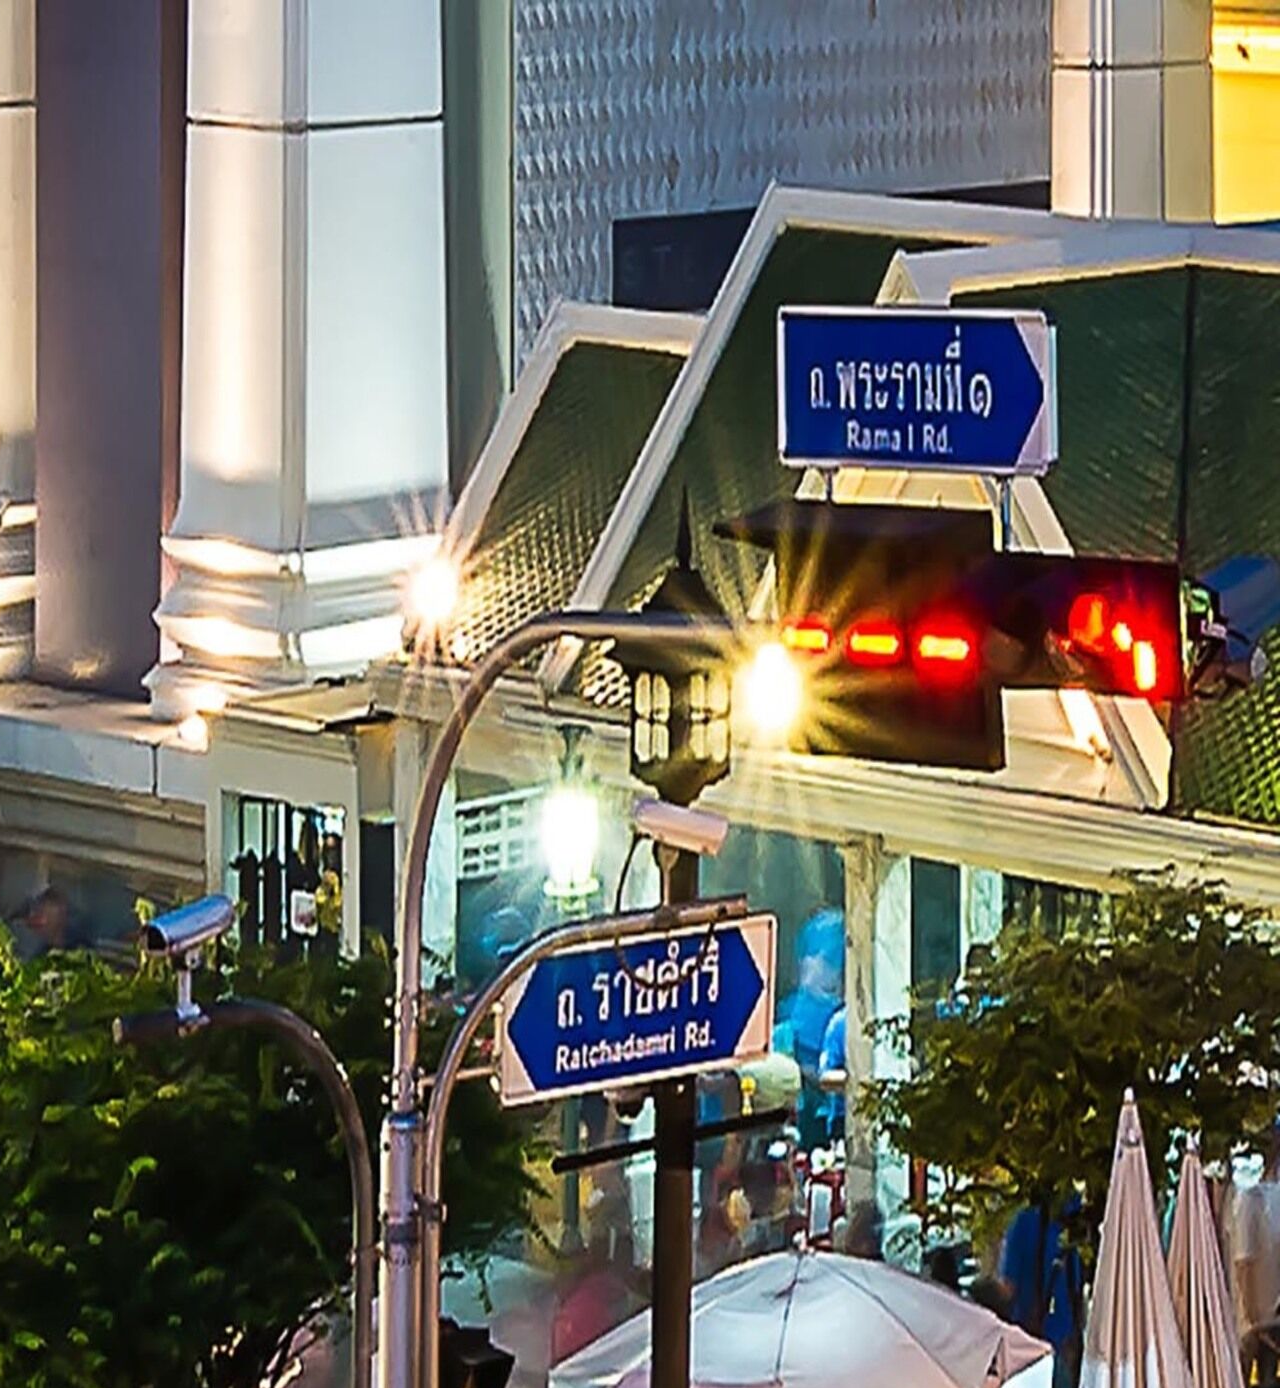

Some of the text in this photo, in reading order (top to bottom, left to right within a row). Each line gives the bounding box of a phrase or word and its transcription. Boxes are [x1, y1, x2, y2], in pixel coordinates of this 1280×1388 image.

[846, 419, 901, 451] Rama
[922, 423, 953, 453] Rd.
[555, 1019, 716, 1074] Ratchadamri Rd.
